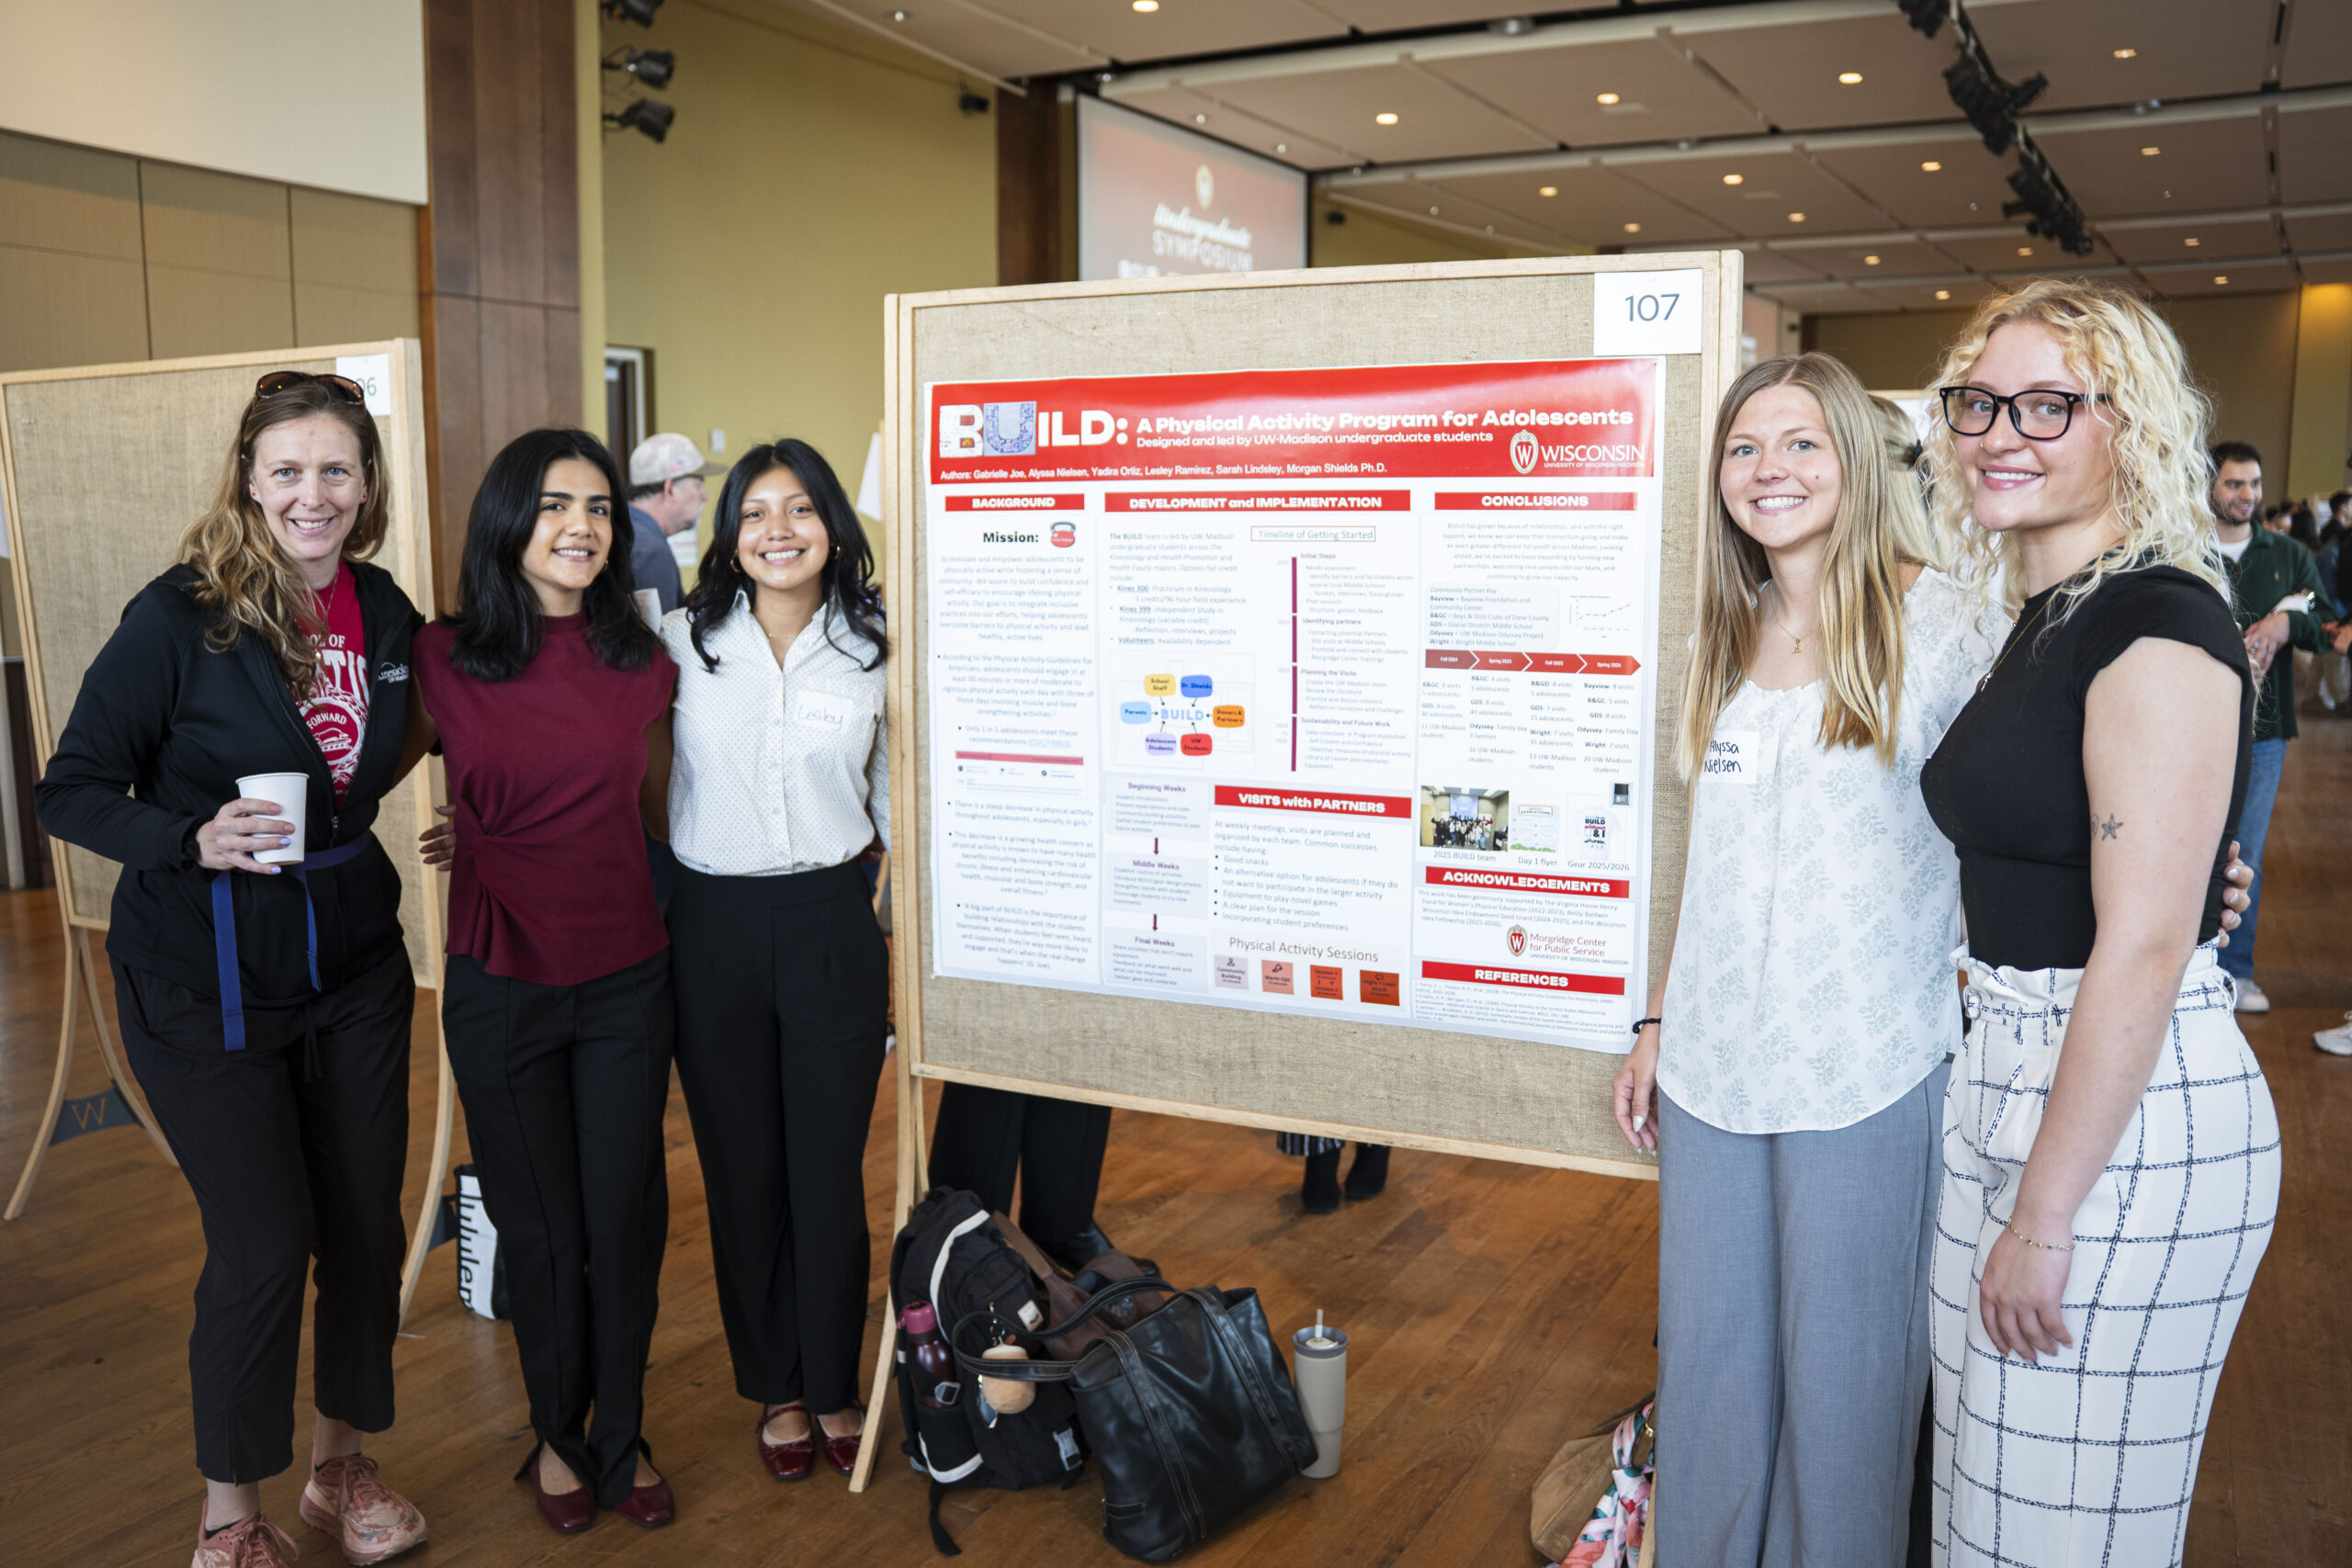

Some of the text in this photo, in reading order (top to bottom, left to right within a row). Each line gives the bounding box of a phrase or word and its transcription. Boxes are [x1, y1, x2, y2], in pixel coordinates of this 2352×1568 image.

[1625, 294, 1679, 321] 107
[356, 377, 377, 396] 06
[1137, 409, 1633, 434] A Physical Activity Program for Adolescents
[939, 401, 1128, 458] BUILD:
[1137, 432, 1493, 448] Designed and led by UW-Madison undergraduate students
[1541, 445, 1645, 462] WISCONSIN
[941, 463, 1386, 479] Authors: Gabrielle Joe, Alyssa Nielsen, Yadira Ortiz, Lesley Ramirez, Sarah Lindsley, Morgan Shields Ph.D.
[972, 497, 1056, 508] BACKGROUND
[1130, 497, 1382, 509] DEVELOPMENT and IMPLEMENTATION
[1482, 496, 1589, 506] CONCLUSIONS
[983, 532, 1038, 543] Mission:
[1260, 530, 1373, 541] Timeline of Getting Started
[329, 634, 345, 648] OF
[306, 712, 347, 729] FORWARD
[1160, 709, 1204, 720] BUILD
[1710, 740, 1739, 756] Alyssa
[1704, 758, 1742, 773] Nielsen
[1128, 782, 1161, 792] Beginning
[1238, 794, 1385, 812] VISITS with PARTNERS
[1324, 829, 1354, 838] planned
[1251, 835, 1261, 843] by
[1305, 839, 1339, 848] Common
[1224, 855, 1243, 863] Good
[1453, 852, 1476, 860] BUILD
[1518, 856, 1557, 866] Day 1 flyer
[1589, 862, 1630, 871] 2025/2026
[1235, 869, 1274, 877] alternative
[1302, 873, 1313, 881] for
[1315, 875, 1360, 885] adolescents
[1368, 880, 1385, 888] they
[1443, 873, 1610, 892] ACKNOWLEDGEMENTS
[1223, 890, 1261, 899] Equipment
[1273, 895, 1289, 903] play
[1266, 884, 1306, 892] participate
[1330, 888, 1352, 897] larger
[1355, 891, 1383, 900] activity
[1250, 904, 1265, 912] plan
[1267, 905, 1277, 913] for
[1223, 914, 1272, 925] Incorporating
[1303, 921, 1348, 931] preferences
[1135, 936, 1174, 947] Final Weeks
[1530, 933, 1606, 946] Morgridge Center
[1229, 937, 1378, 962] Physical Activity Sessions
[1530, 943, 1604, 956] for Public Service
[1475, 970, 1568, 987] REFERENCES
[71, 1097, 106, 1131] W
